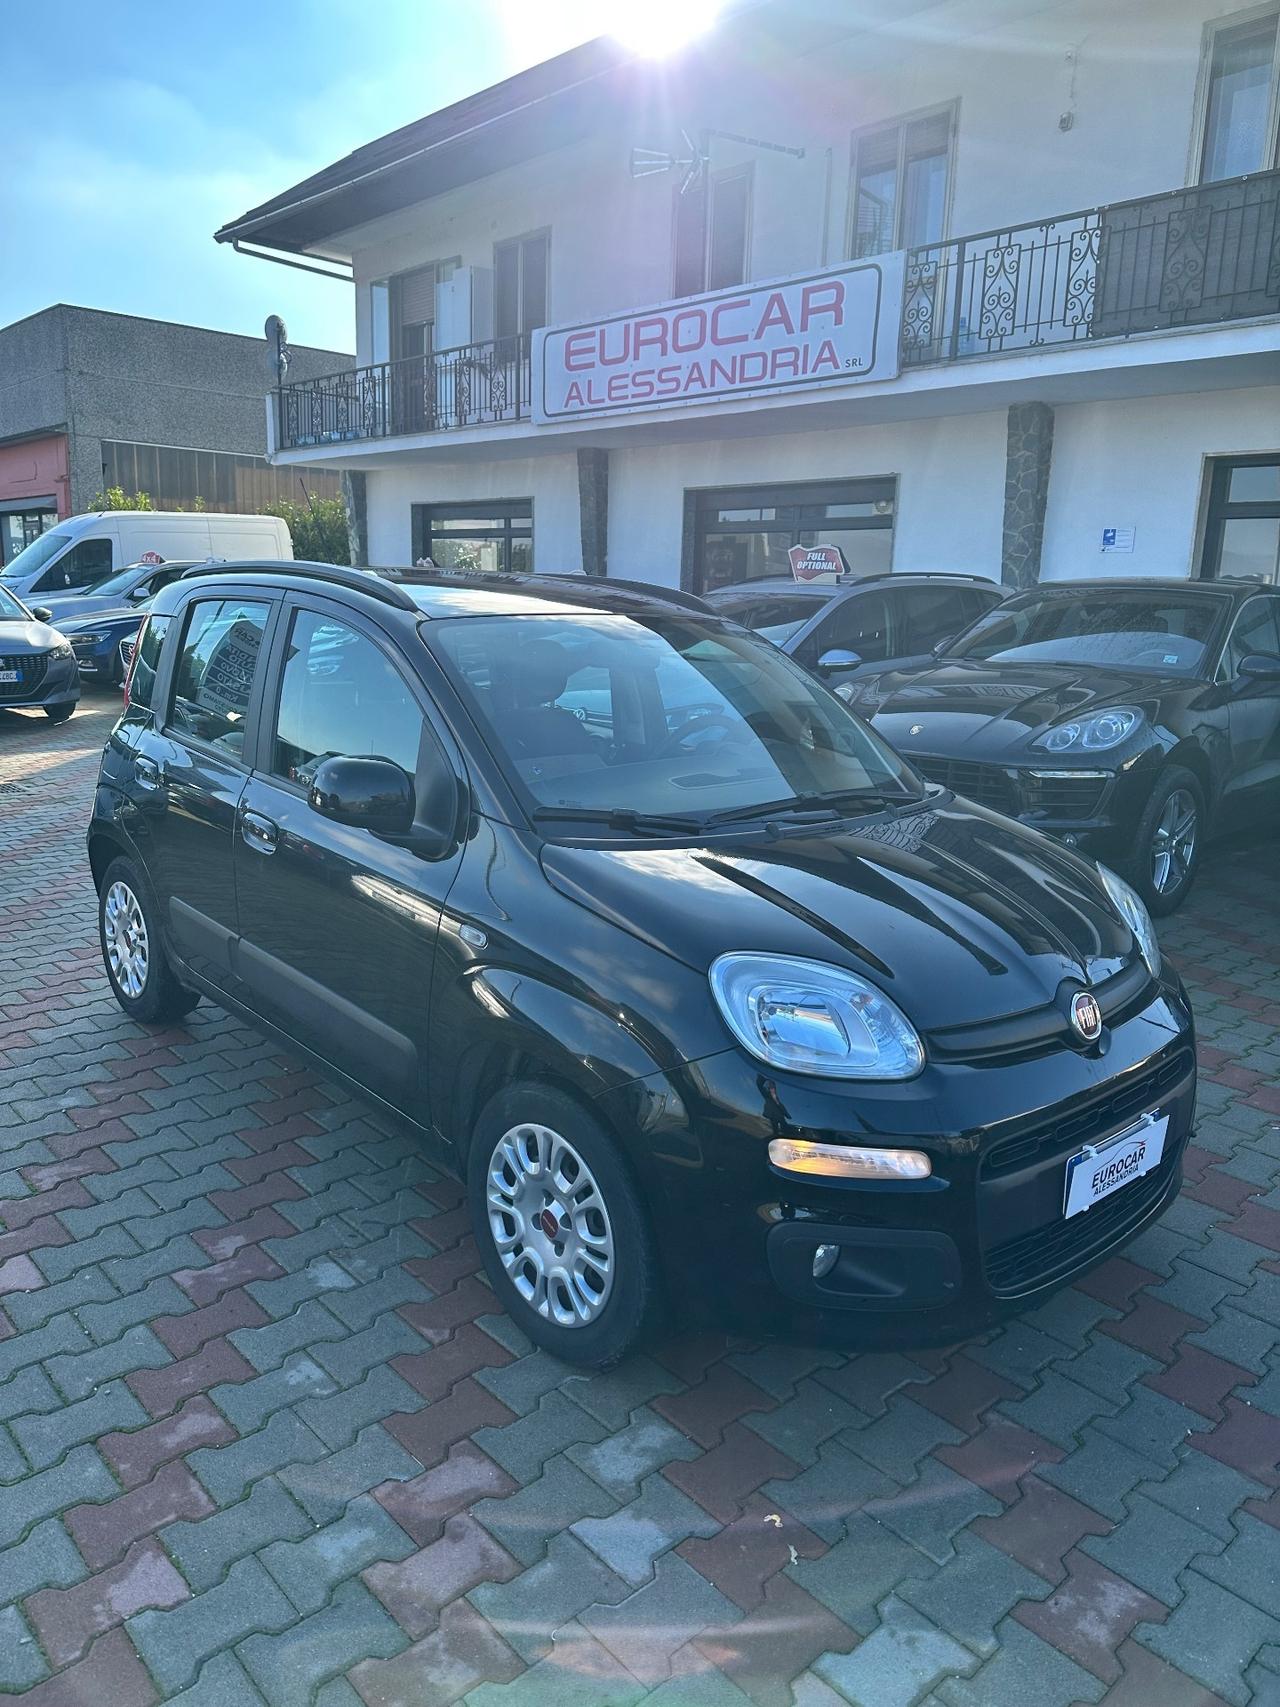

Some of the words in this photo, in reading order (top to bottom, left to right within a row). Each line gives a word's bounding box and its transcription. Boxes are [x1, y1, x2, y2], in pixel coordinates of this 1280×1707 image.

[563, 280, 846, 372] EUROCAR
[563, 339, 841, 409] ALESSANDRIA
[845, 357, 863, 369] SRL
[796, 560, 837, 570] OPTIONAL
[806, 552, 826, 561] FULL
[1077, 1004, 1097, 1029] FIAT
[1092, 1147, 1146, 1189] EUROCAR
[1093, 1164, 1139, 1197] ALESSANDRIA
